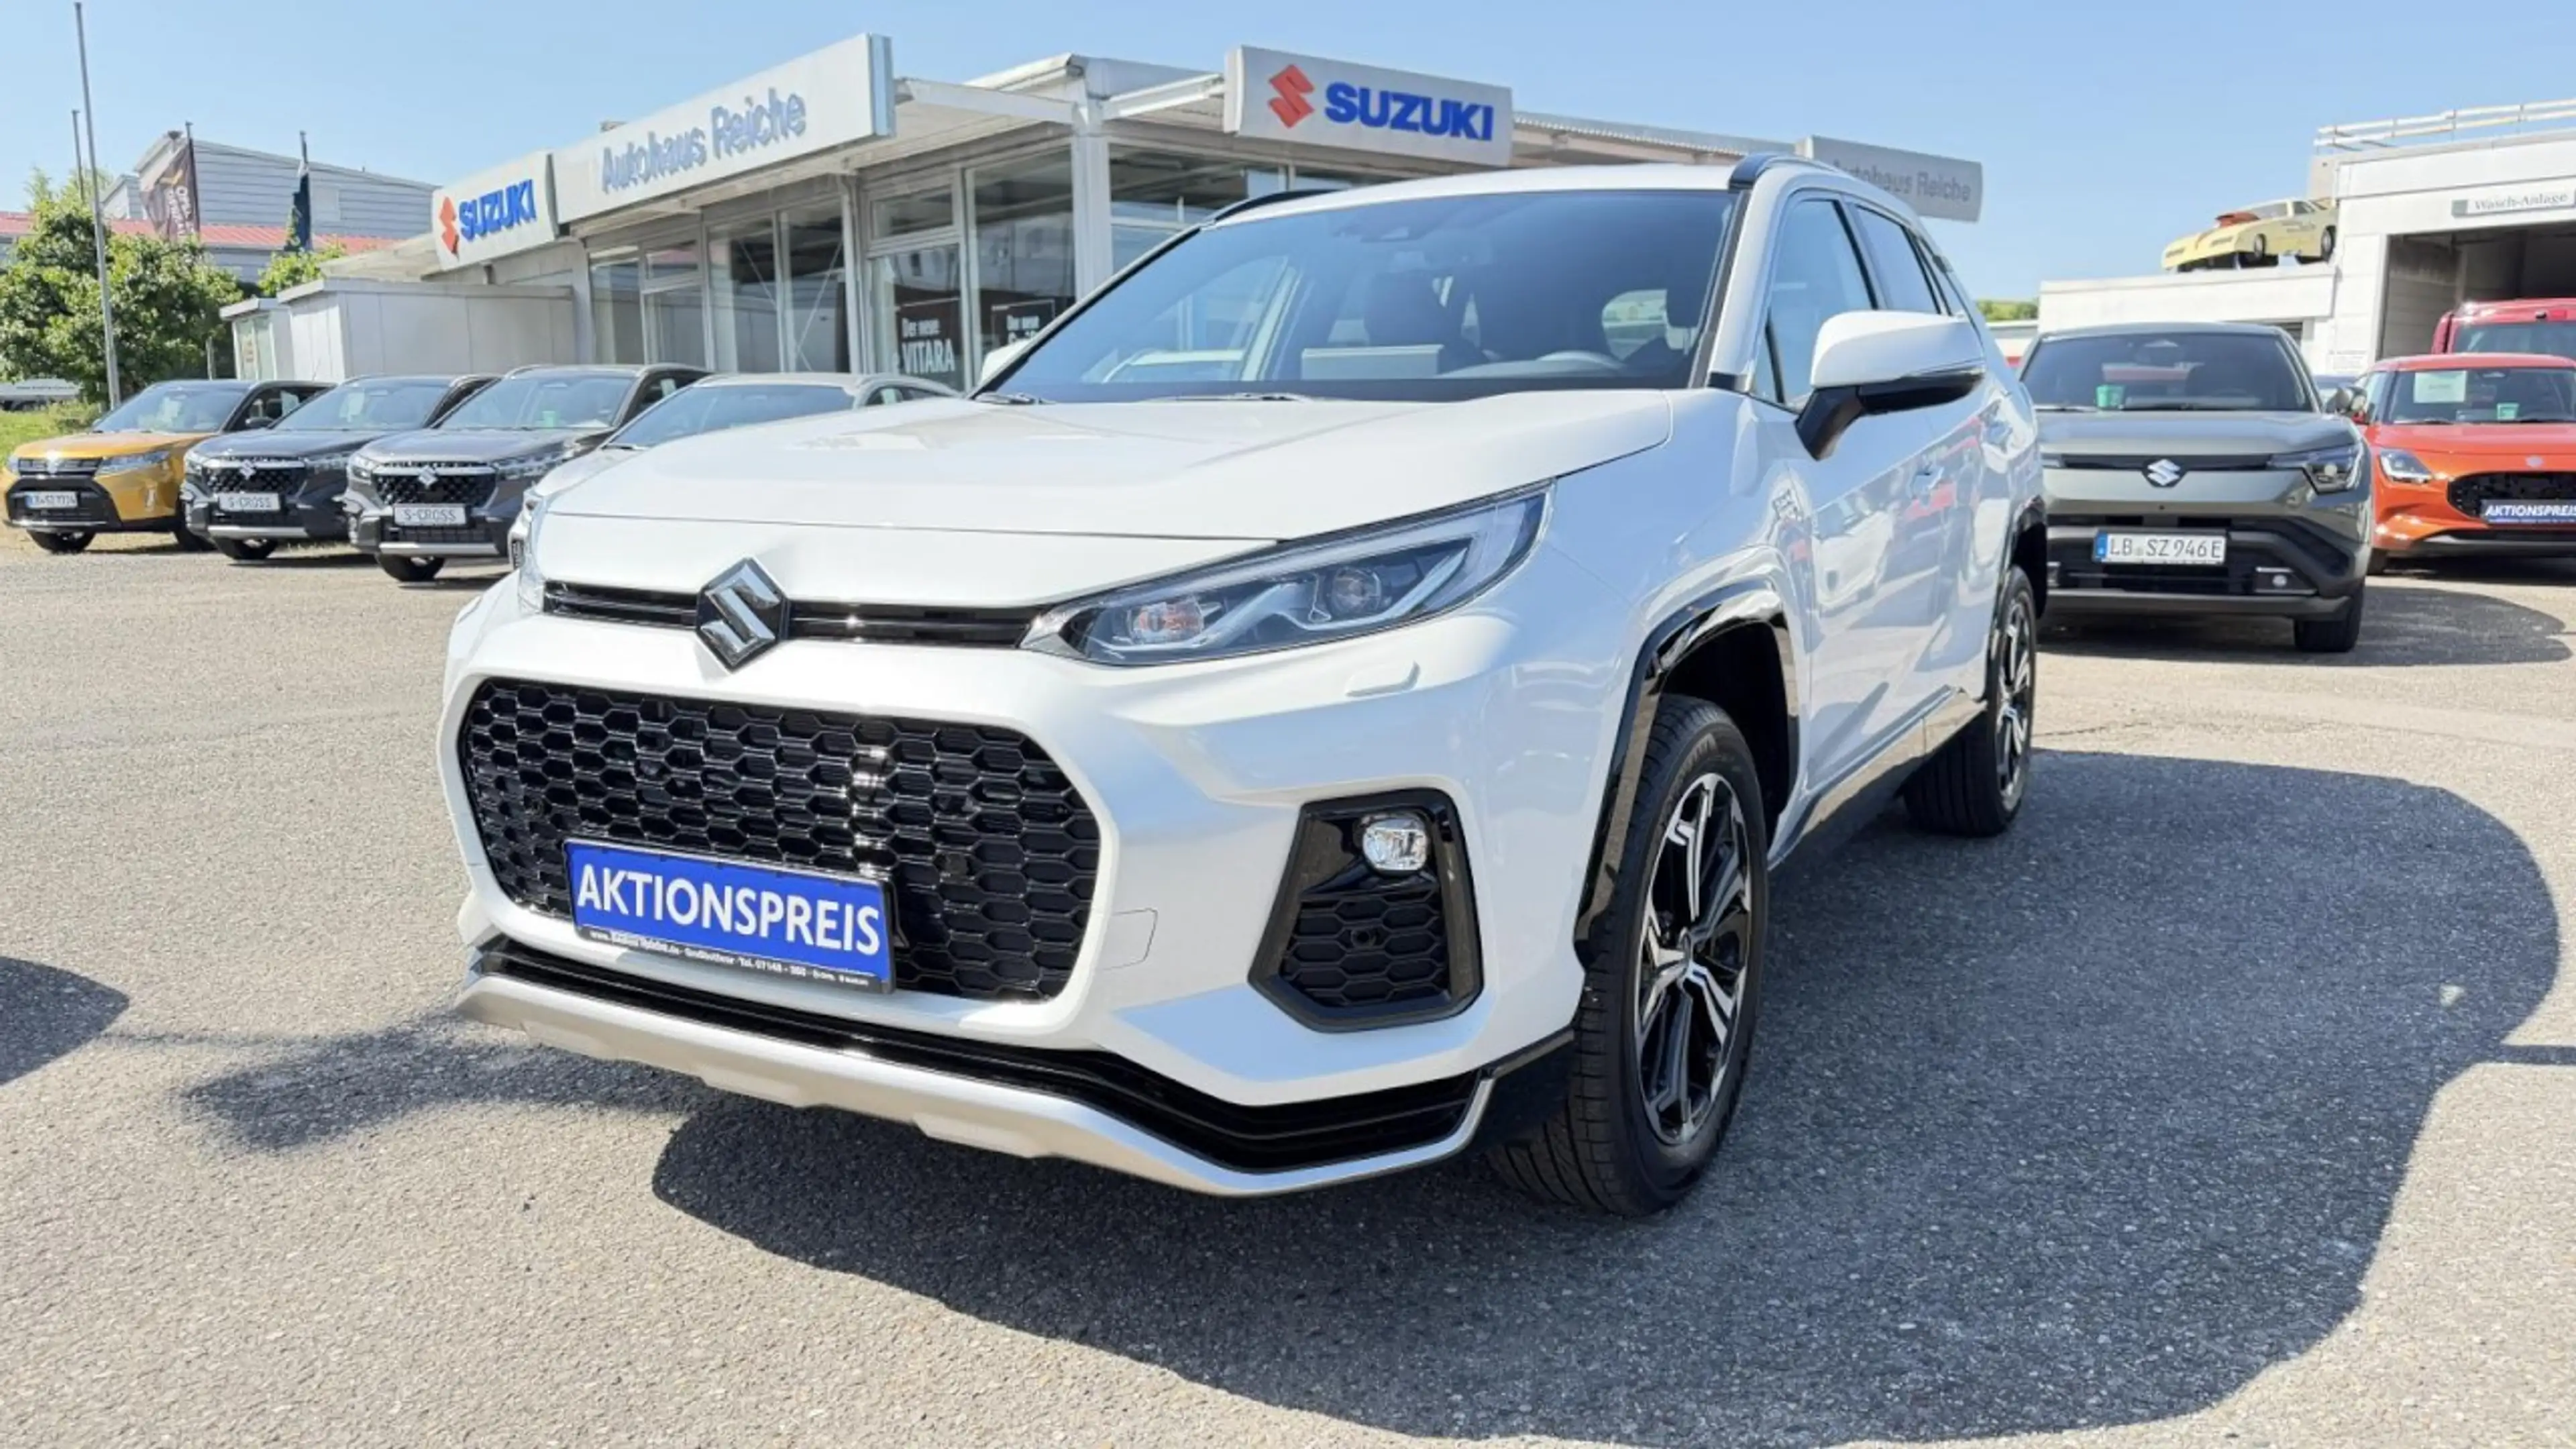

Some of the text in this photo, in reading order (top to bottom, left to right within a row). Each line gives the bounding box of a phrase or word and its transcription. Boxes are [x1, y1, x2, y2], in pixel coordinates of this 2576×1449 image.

[1324, 81, 1493, 142] SUZUKI
[602, 87, 806, 194] Autohaus Reiche
[1833, 159, 1972, 203] tohaus Reiche
[459, 178, 537, 242] SUZUKI
[902, 338, 955, 374] VITARA
[404, 508, 457, 521] S-CROSS
[2110, 538, 2133, 555] LB
[2145, 539, 2169, 557] SZ
[578, 864, 880, 955] AKTIONSPREIS
